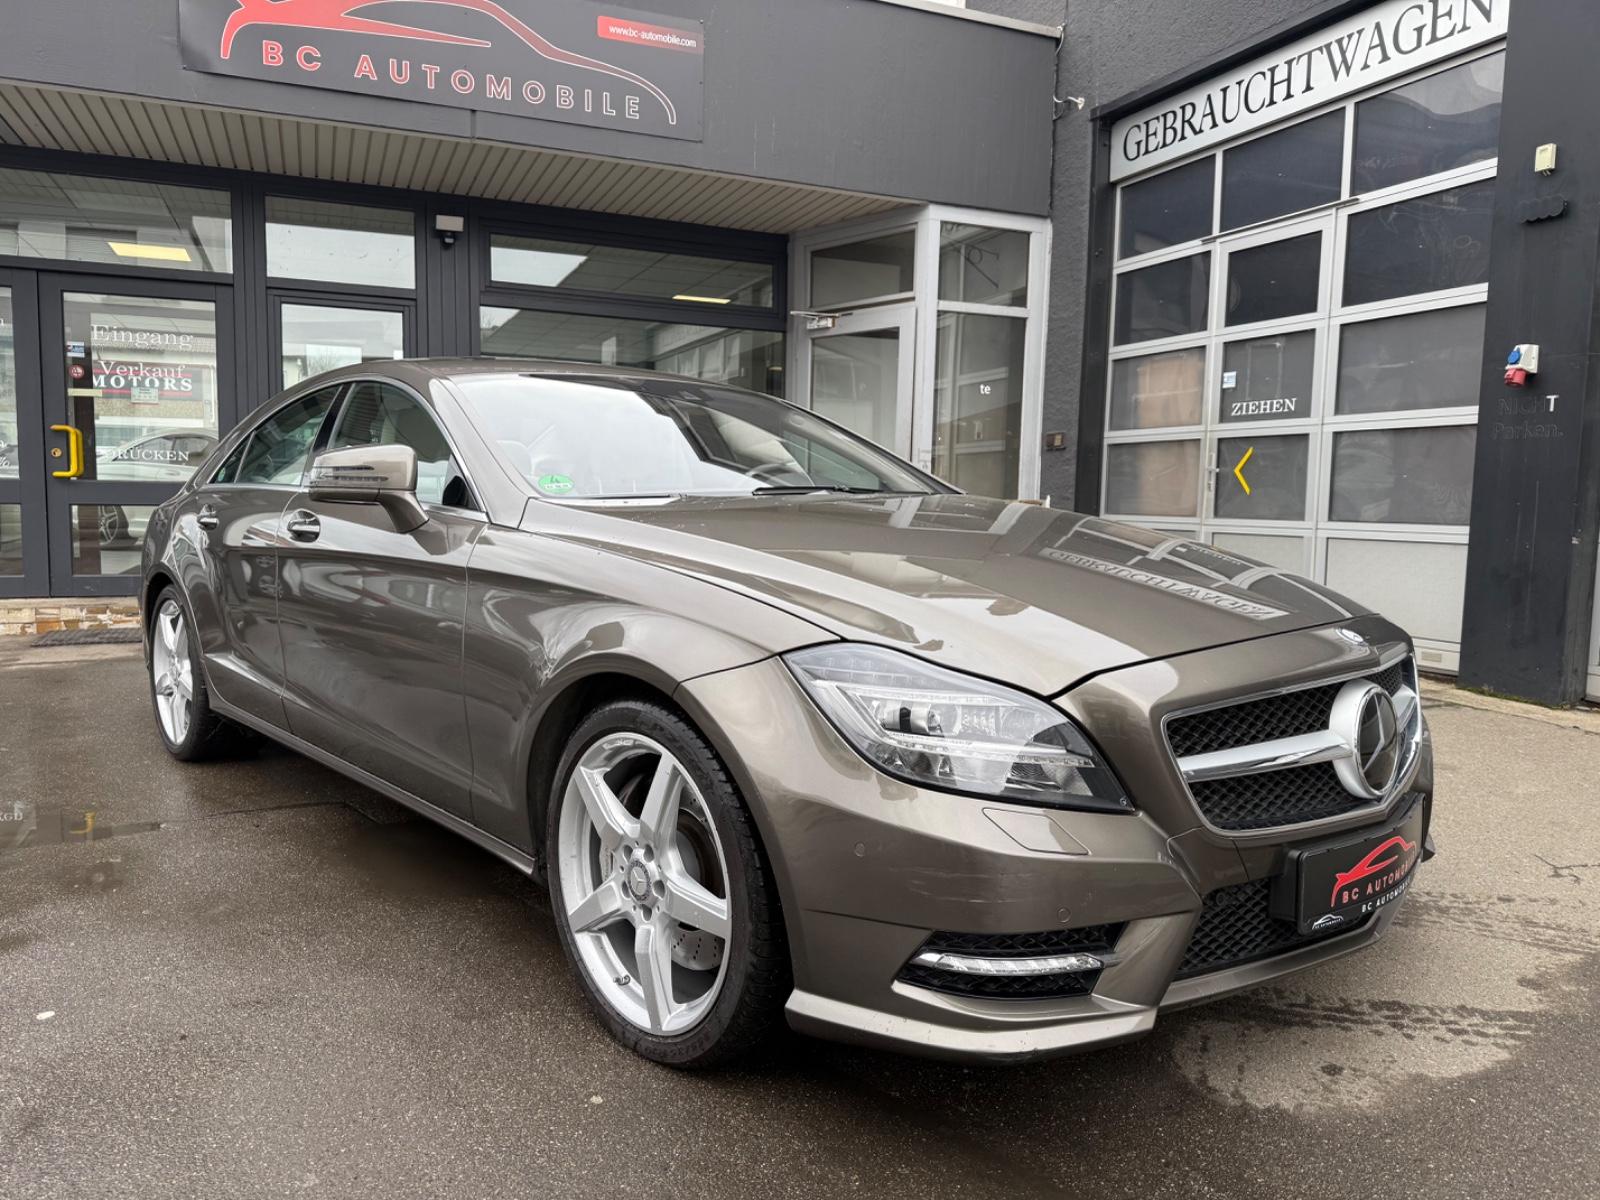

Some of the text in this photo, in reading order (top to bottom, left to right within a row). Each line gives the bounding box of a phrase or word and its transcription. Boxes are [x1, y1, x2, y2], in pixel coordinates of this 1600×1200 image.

[608, 25, 697, 48] www.bc-automobile.com
[262, 39, 640, 120] BC AUTOMOBILE
[1123, 0, 1493, 162] GEBRAUCHTWAGEN
[90, 324, 194, 350] Eingang
[98, 360, 187, 379] Verkauf
[93, 373, 193, 392] MOTORS
[1231, 397, 1298, 417] ZIEHEN
[1341, 887, 1360, 905] BC
[1361, 901, 1373, 913] BC
